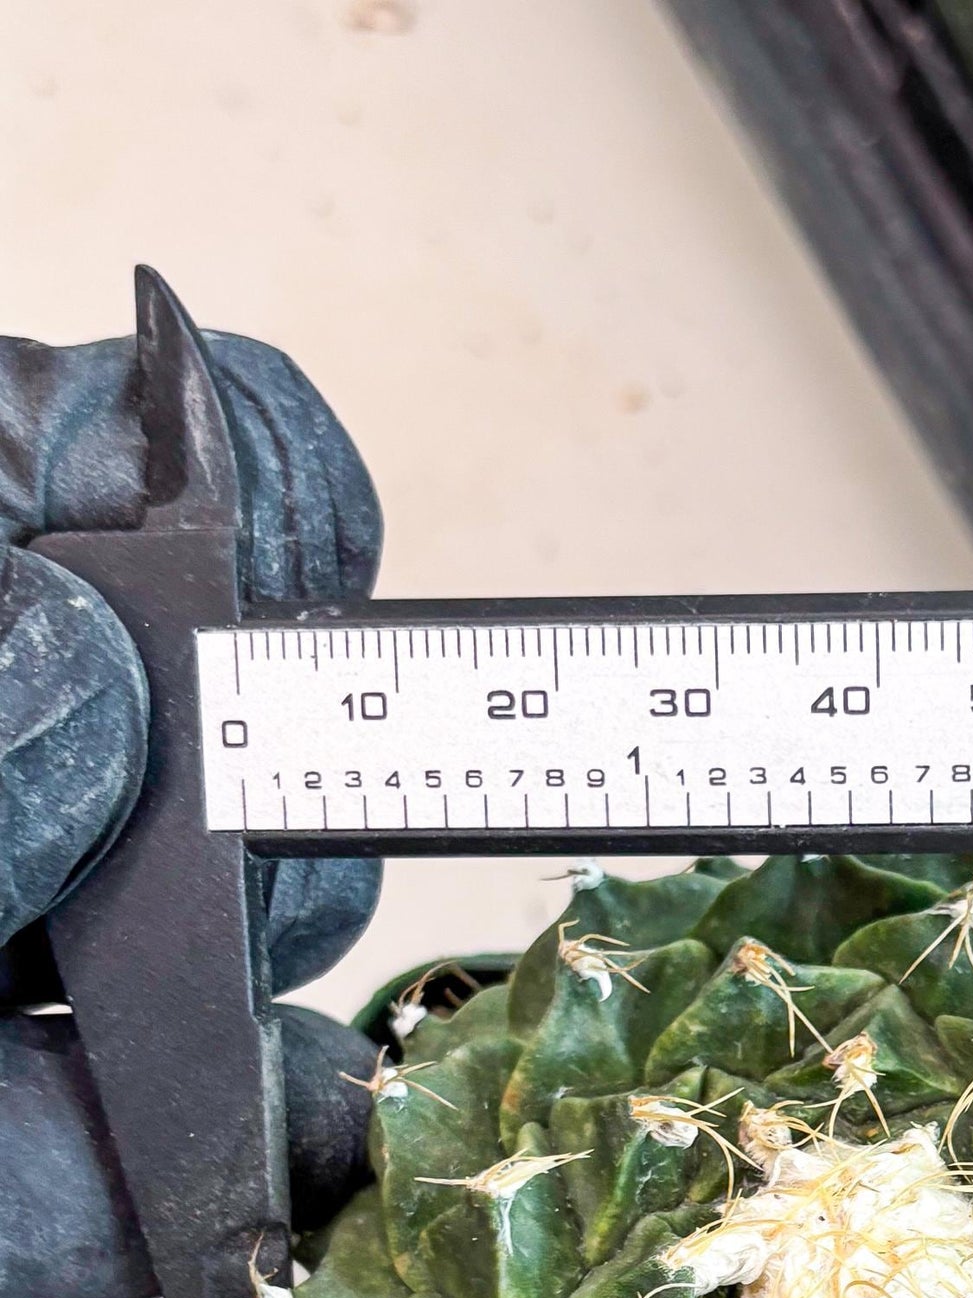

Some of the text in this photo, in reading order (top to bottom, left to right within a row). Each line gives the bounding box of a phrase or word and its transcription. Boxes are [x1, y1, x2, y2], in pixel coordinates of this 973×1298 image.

[341, 692, 388, 721] 10
[486, 689, 549, 720] 20
[649, 688, 711, 718] 30
[810, 686, 870, 717] 40
[221, 720, 248, 749] 0
[627, 745, 641, 775] 1
[273, 771, 280, 789] 1
[304, 771, 322, 790] 2
[344, 770, 362, 788] 3
[384, 770, 401, 789] 4
[425, 769, 442, 788] 5
[465, 769, 483, 788] 6
[509, 769, 524, 787] 7
[545, 769, 565, 787] 8
[586, 768, 605, 788] 9
[676, 769, 685, 786] 1
[708, 767, 727, 786] 2
[749, 766, 767, 785] 3
[789, 766, 806, 785] 4
[830, 766, 847, 785] 5
[870, 765, 889, 784] 6
[915, 765, 930, 783] 7
[951, 764, 971, 783] 8
